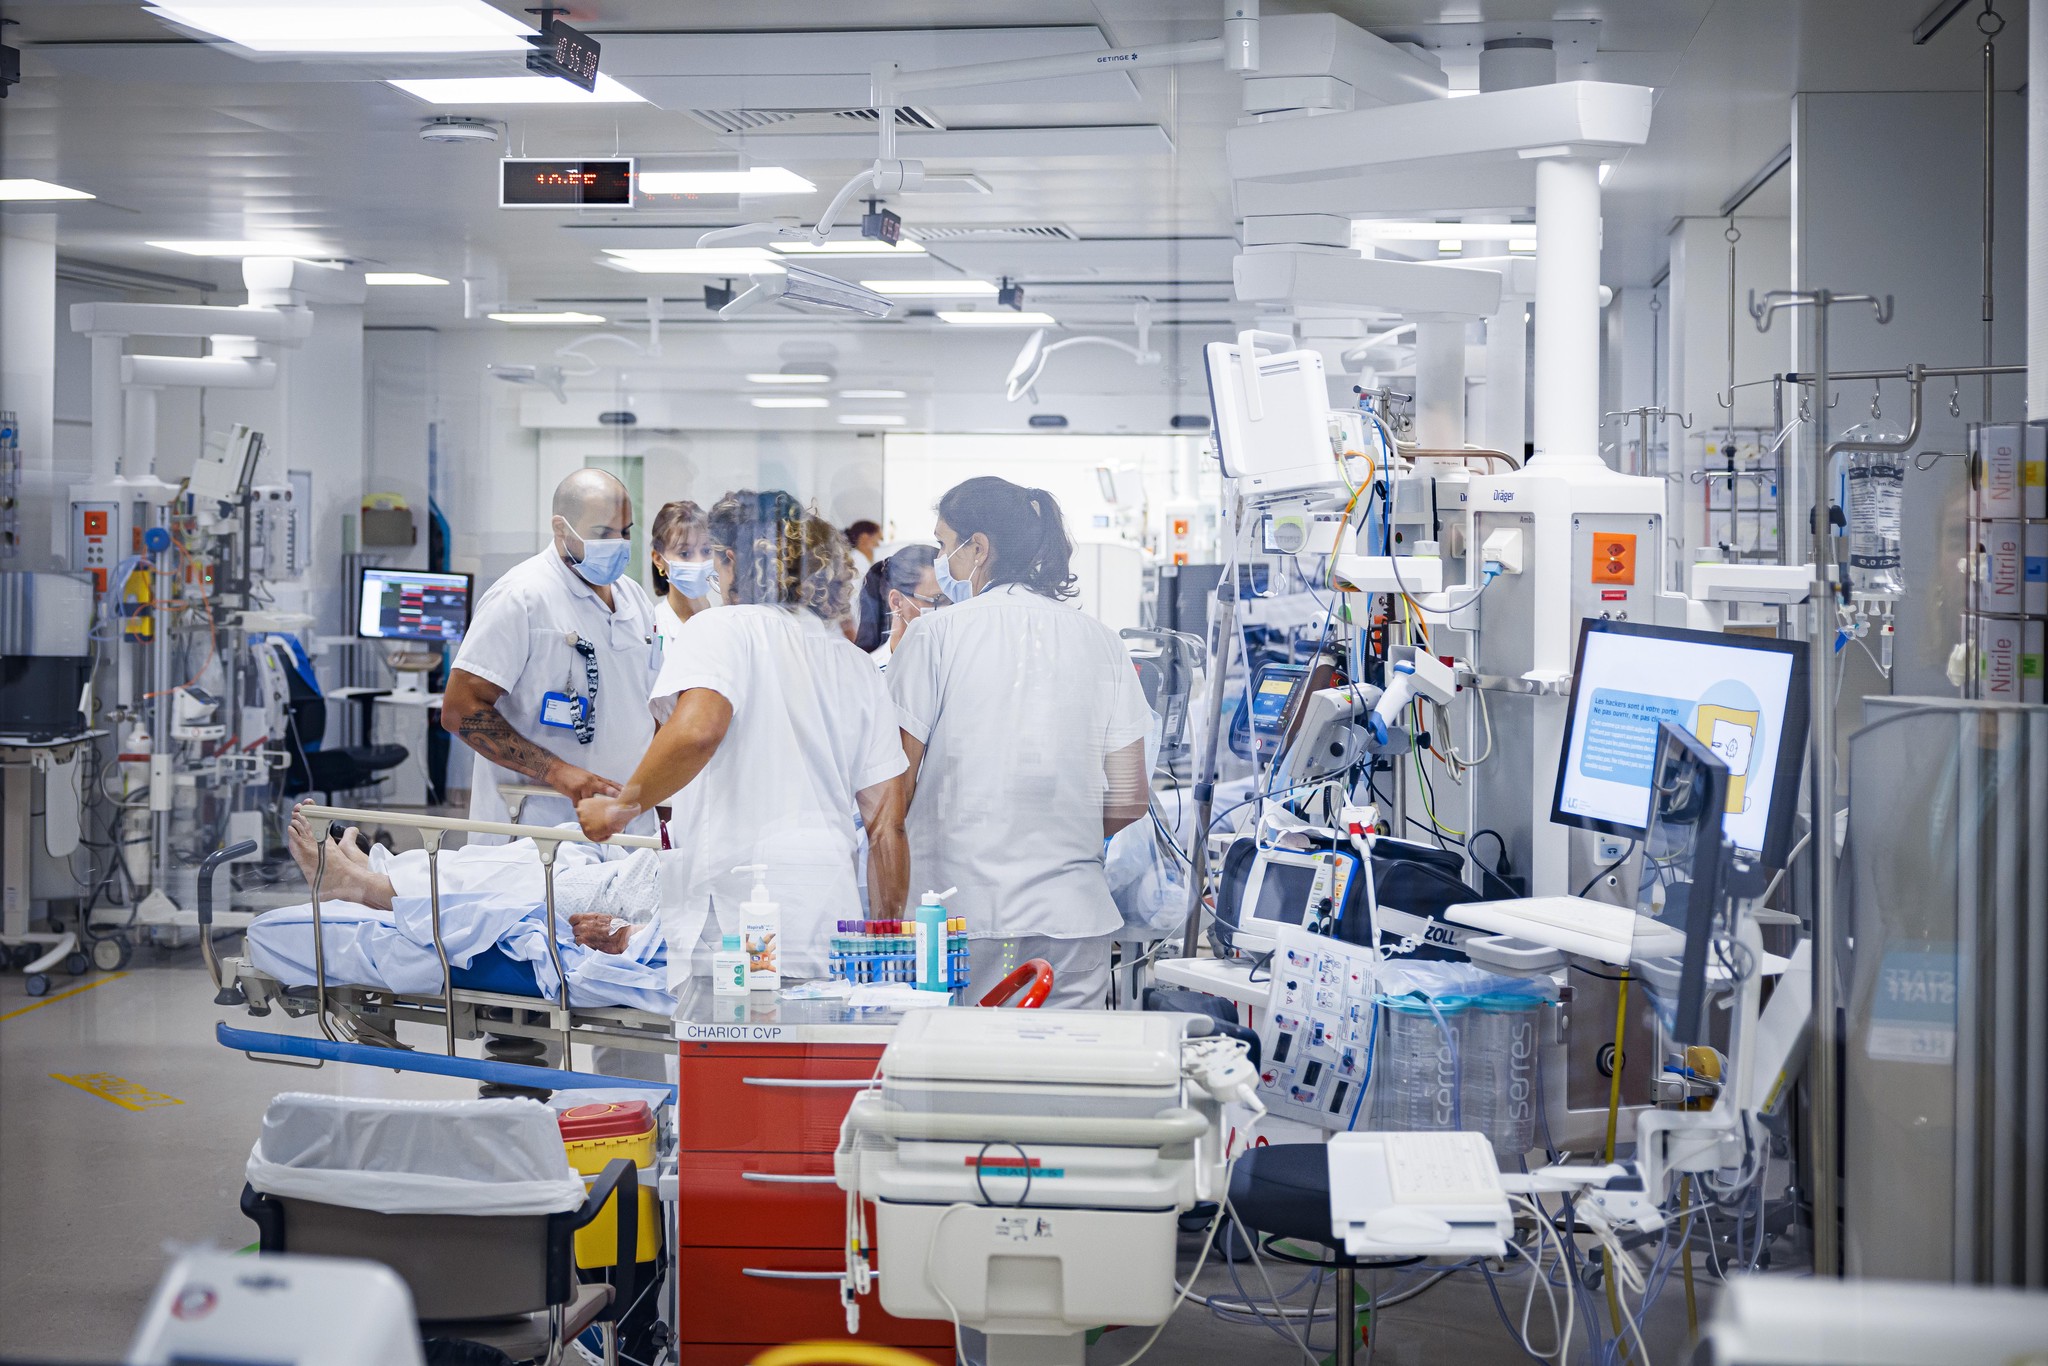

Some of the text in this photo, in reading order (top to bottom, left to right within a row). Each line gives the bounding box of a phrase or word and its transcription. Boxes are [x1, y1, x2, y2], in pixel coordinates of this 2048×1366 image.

[568, 43, 582, 71] 55
[1097, 54, 1130, 63] GETINGE
[1992, 446, 2011, 500] Nitrile
[1493, 489, 1515, 503] Dräger
[1995, 541, 2016, 596] Nitrile
[2028, 565, 2041, 575] L
[1991, 638, 2012, 693] Nitrile
[2023, 658, 2037, 674] M
[1593, 706, 1602, 715] Ne
[1602, 709, 1612, 717] pas
[1640, 714, 1650, 722] pas
[1594, 697, 1604, 705] Les
[1605, 699, 1626, 709] hackers
[1627, 703, 1640, 711] sont
[1645, 705, 1660, 714] votre
[1661, 707, 1679, 717] porte!
[1424, 925, 1455, 946] ZOLL
[687, 1026, 782, 1039] CHARIOT CVP
[1509, 1022, 1532, 1120] serres
